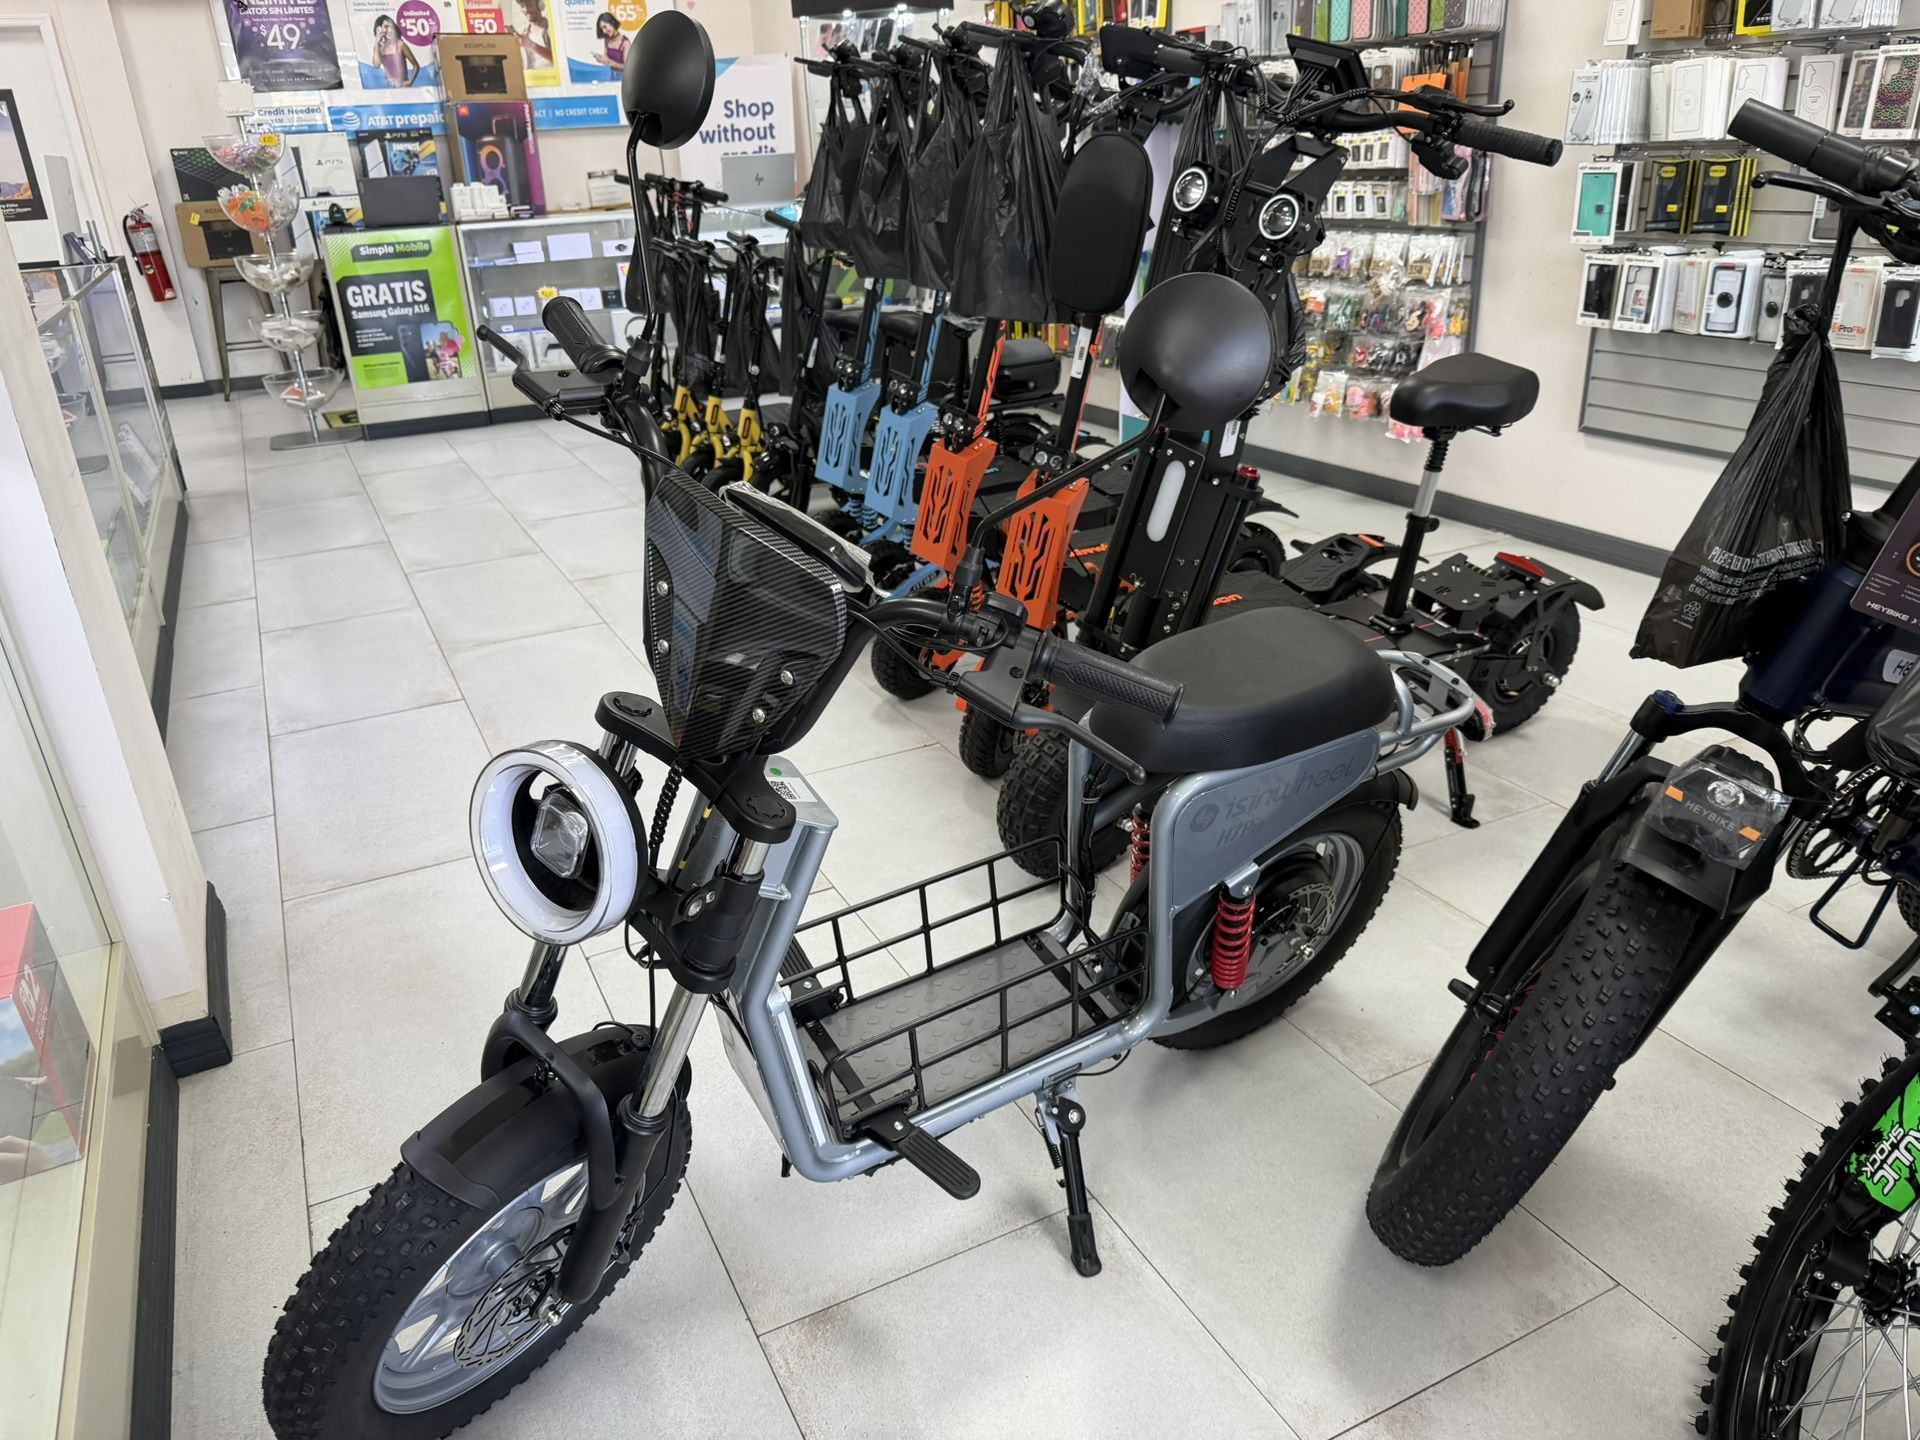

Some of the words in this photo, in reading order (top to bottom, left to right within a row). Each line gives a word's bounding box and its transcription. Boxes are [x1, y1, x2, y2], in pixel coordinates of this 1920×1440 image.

[269, 6, 282, 15] SIN
[257, 107, 286, 117] Credit
[287, 106, 322, 116] Needed
[367, 115, 394, 126] AT&T
[555, 109, 565, 118] NO
[565, 108, 588, 117] CREDIT
[588, 107, 609, 116] CHECK
[724, 98, 775, 121] Shop
[699, 122, 777, 145] without
[359, 244, 395, 257] Simple
[395, 242, 430, 254] Mobile
[346, 280, 428, 308] GRATIS
[351, 307, 388, 320] Samsung
[387, 305, 414, 317] Galaxy
[413, 303, 430, 315] A16
[1866, 600, 1910, 622] HEYBIKE
[1224, 754, 1356, 820] isinwheel
[1684, 799, 1737, 833] HEYBIKE
[1861, 1123, 1905, 1178] SHOCK
[1873, 1128, 1920, 1196] ULIC
